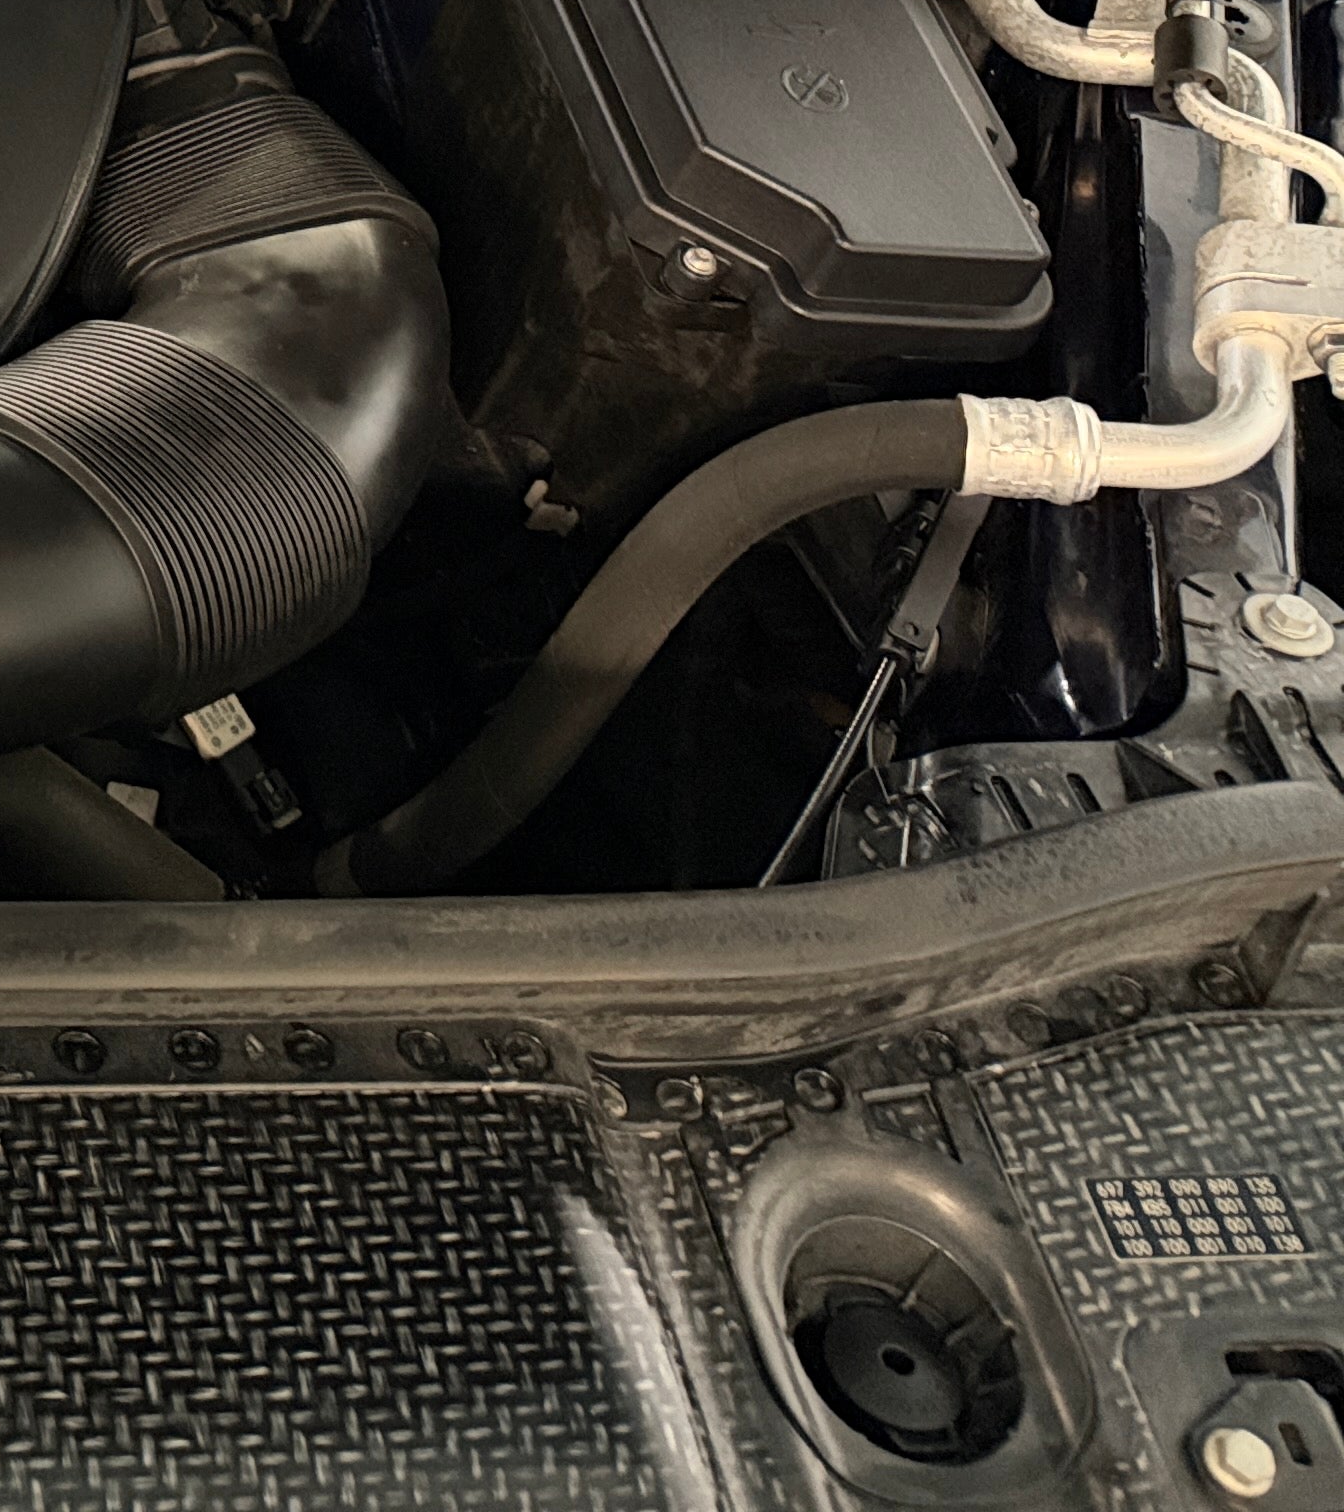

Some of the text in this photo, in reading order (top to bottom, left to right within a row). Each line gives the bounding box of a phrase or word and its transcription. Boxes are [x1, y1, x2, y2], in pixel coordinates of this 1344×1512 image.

[1178, 1198, 1209, 1215] 011
[1215, 1197, 1246, 1214] 001
[1253, 1196, 1285, 1213] 100
[1113, 1215, 1293, 1237] 101 110 000 001 101
[1122, 1238, 1153, 1256] 100
[1159, 1237, 1190, 1255] 100
[1195, 1237, 1227, 1254] 001
